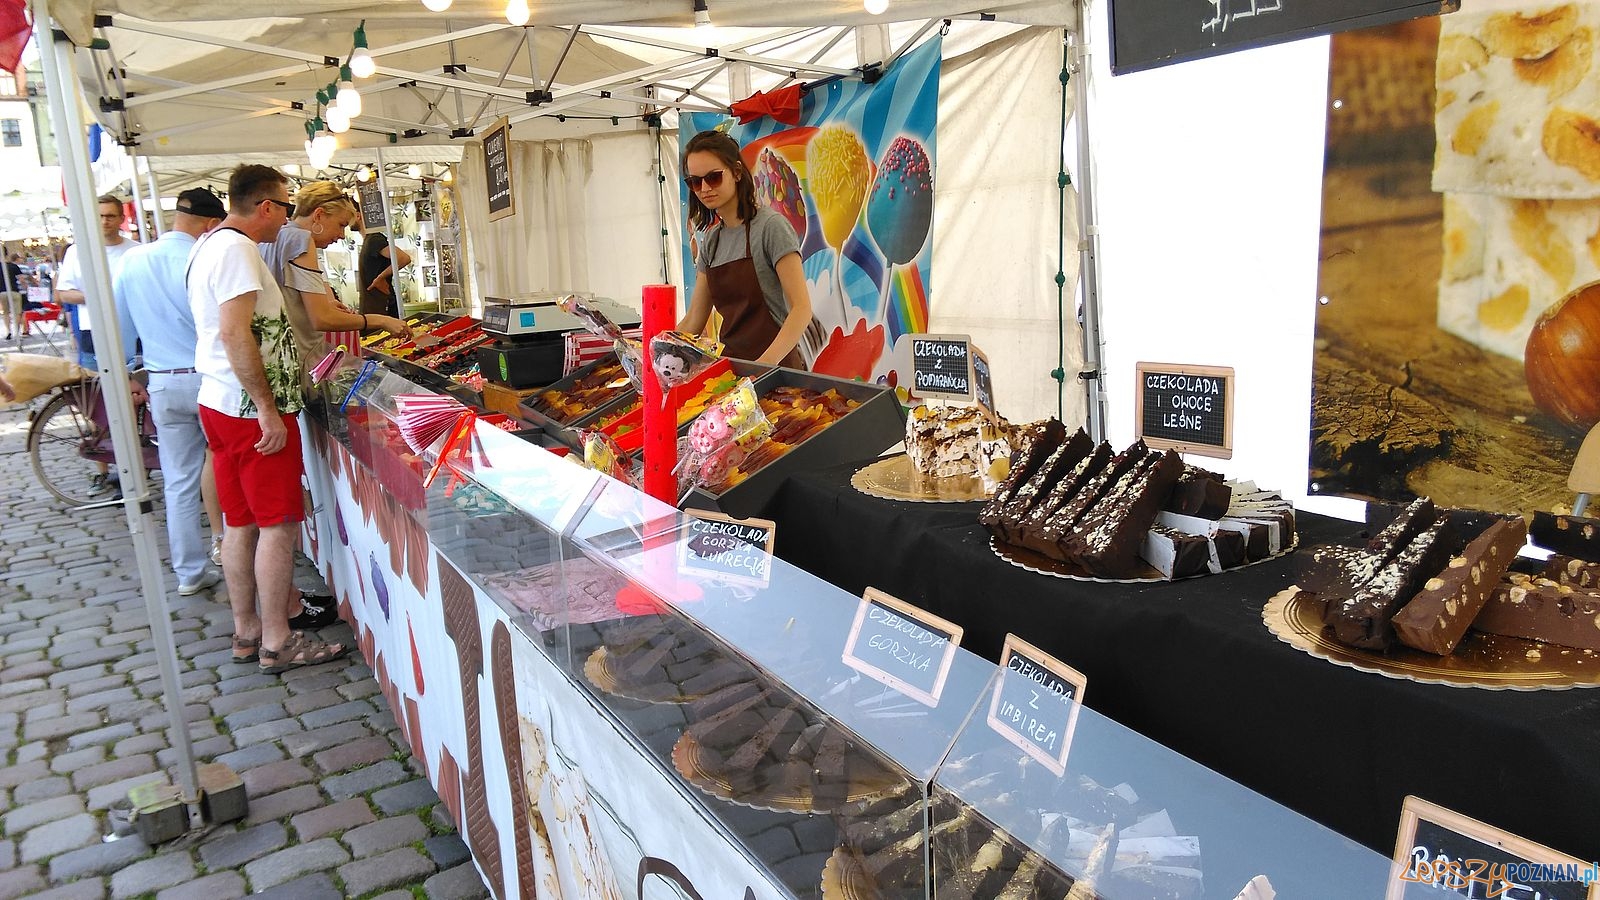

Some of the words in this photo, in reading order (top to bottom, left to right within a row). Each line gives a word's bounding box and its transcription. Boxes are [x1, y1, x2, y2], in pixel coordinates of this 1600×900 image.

[914, 341, 966, 357] CZEKOLADA
[1146, 375, 1219, 394] CZEKOLADA
[1157, 395, 1161, 407] I
[1171, 395, 1212, 412] OWOCE
[1163, 410, 1202, 431] LEŚNE
[693, 521, 771, 544] CZEKOLADA
[688, 550, 697, 560] Z
[702, 536, 754, 555] GORZKA
[869, 608, 948, 648] CZEKOLADA
[868, 634, 932, 672] GORZKA
[1008, 655, 1072, 705] CZEKOLADA
[1027, 690, 1039, 710] Z
[1000, 701, 1057, 750] IMBIREM
